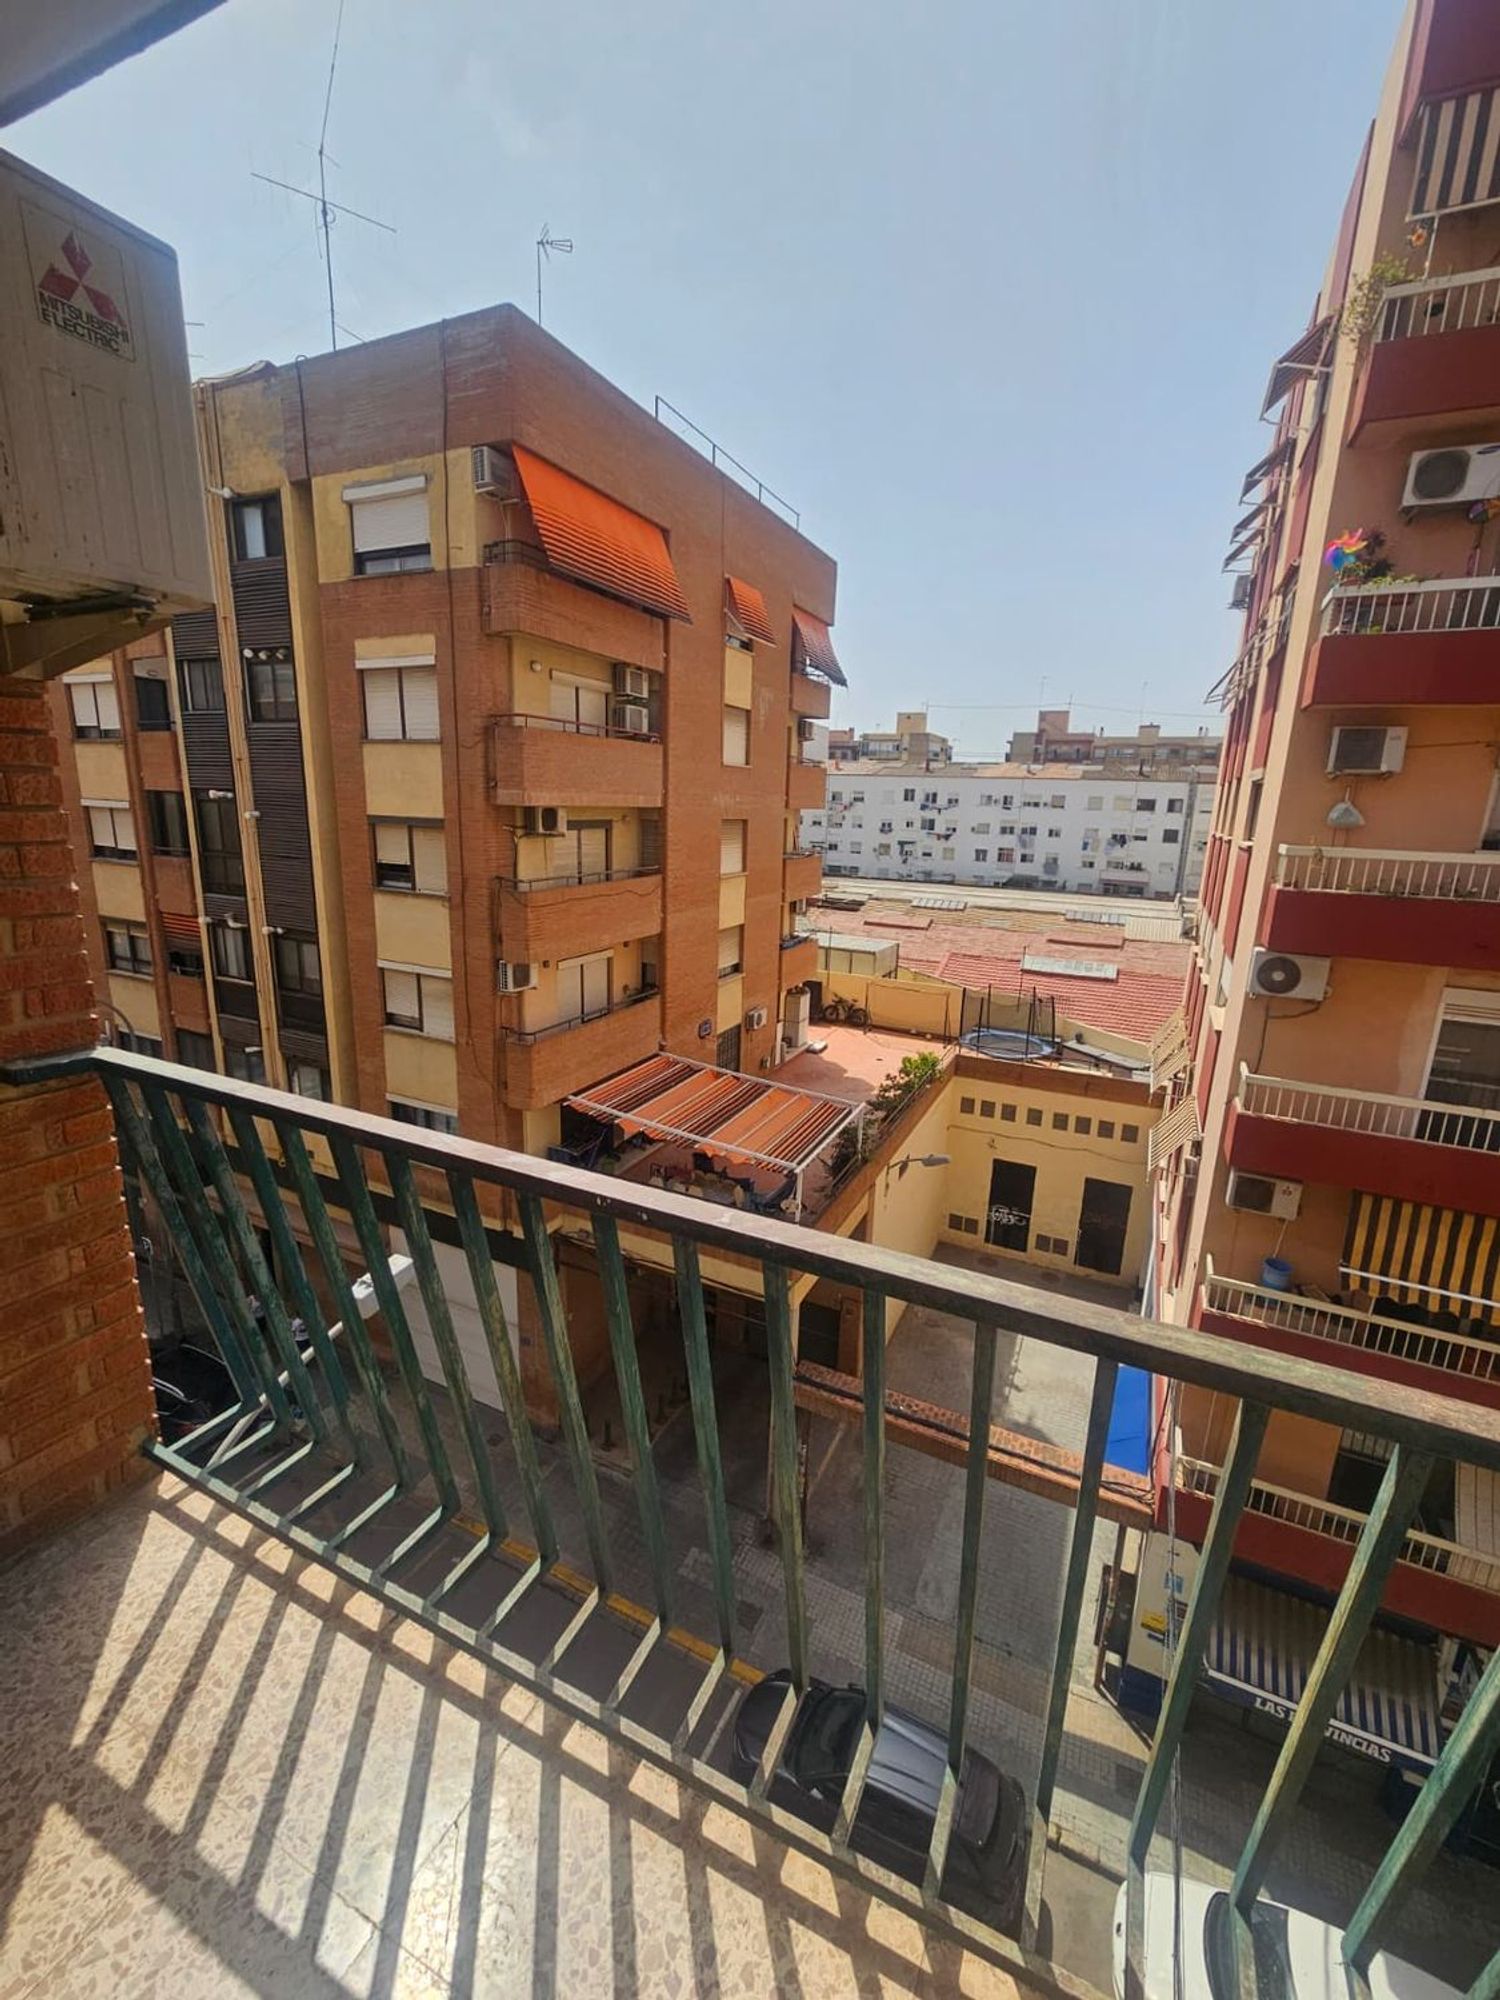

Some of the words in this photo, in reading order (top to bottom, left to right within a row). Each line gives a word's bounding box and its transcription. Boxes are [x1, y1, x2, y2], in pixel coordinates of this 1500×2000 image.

[38, 290, 129, 344] MITSUBISHI
[41, 307, 120, 352] ELECTRIC
[1254, 1697, 1287, 1720] LAS
[1288, 1710, 1392, 1763] VINCIAS
